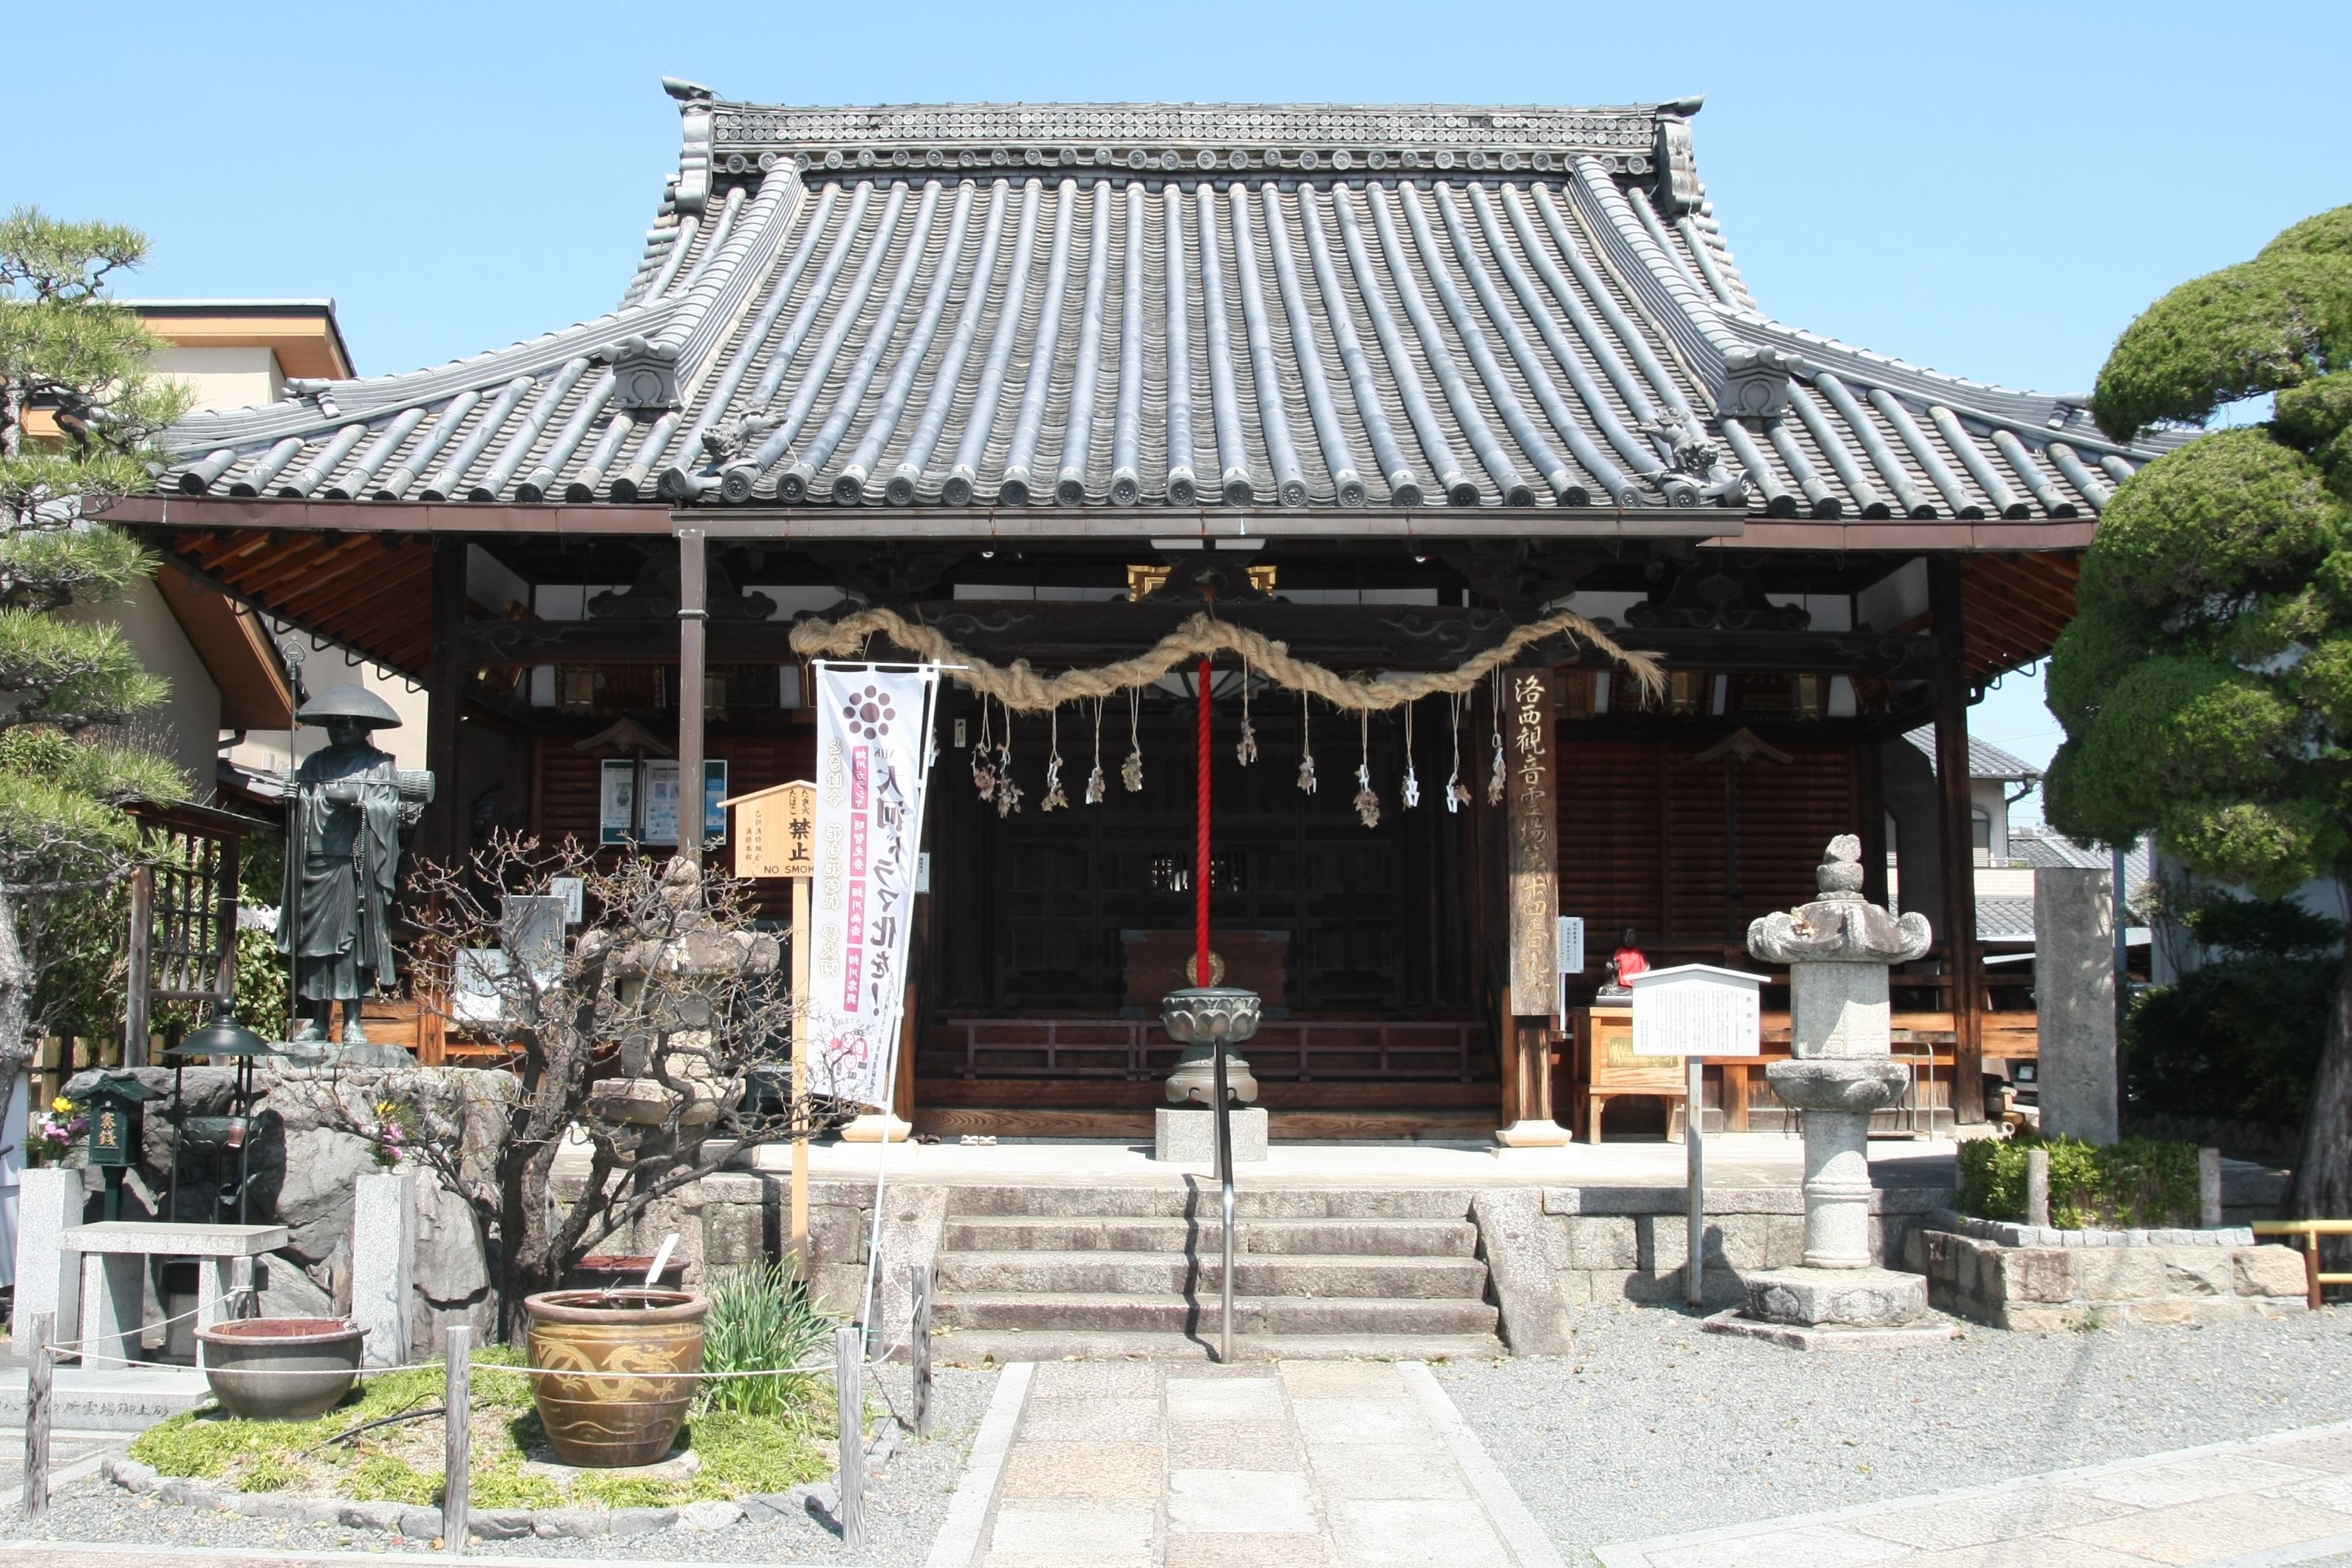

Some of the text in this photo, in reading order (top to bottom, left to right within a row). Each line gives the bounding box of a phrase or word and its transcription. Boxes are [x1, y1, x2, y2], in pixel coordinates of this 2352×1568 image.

[788, 788, 799, 815] たばこ
[801, 788, 811, 815] たき火
[788, 817, 811, 862] 禁止
[764, 865, 780, 873] NO
